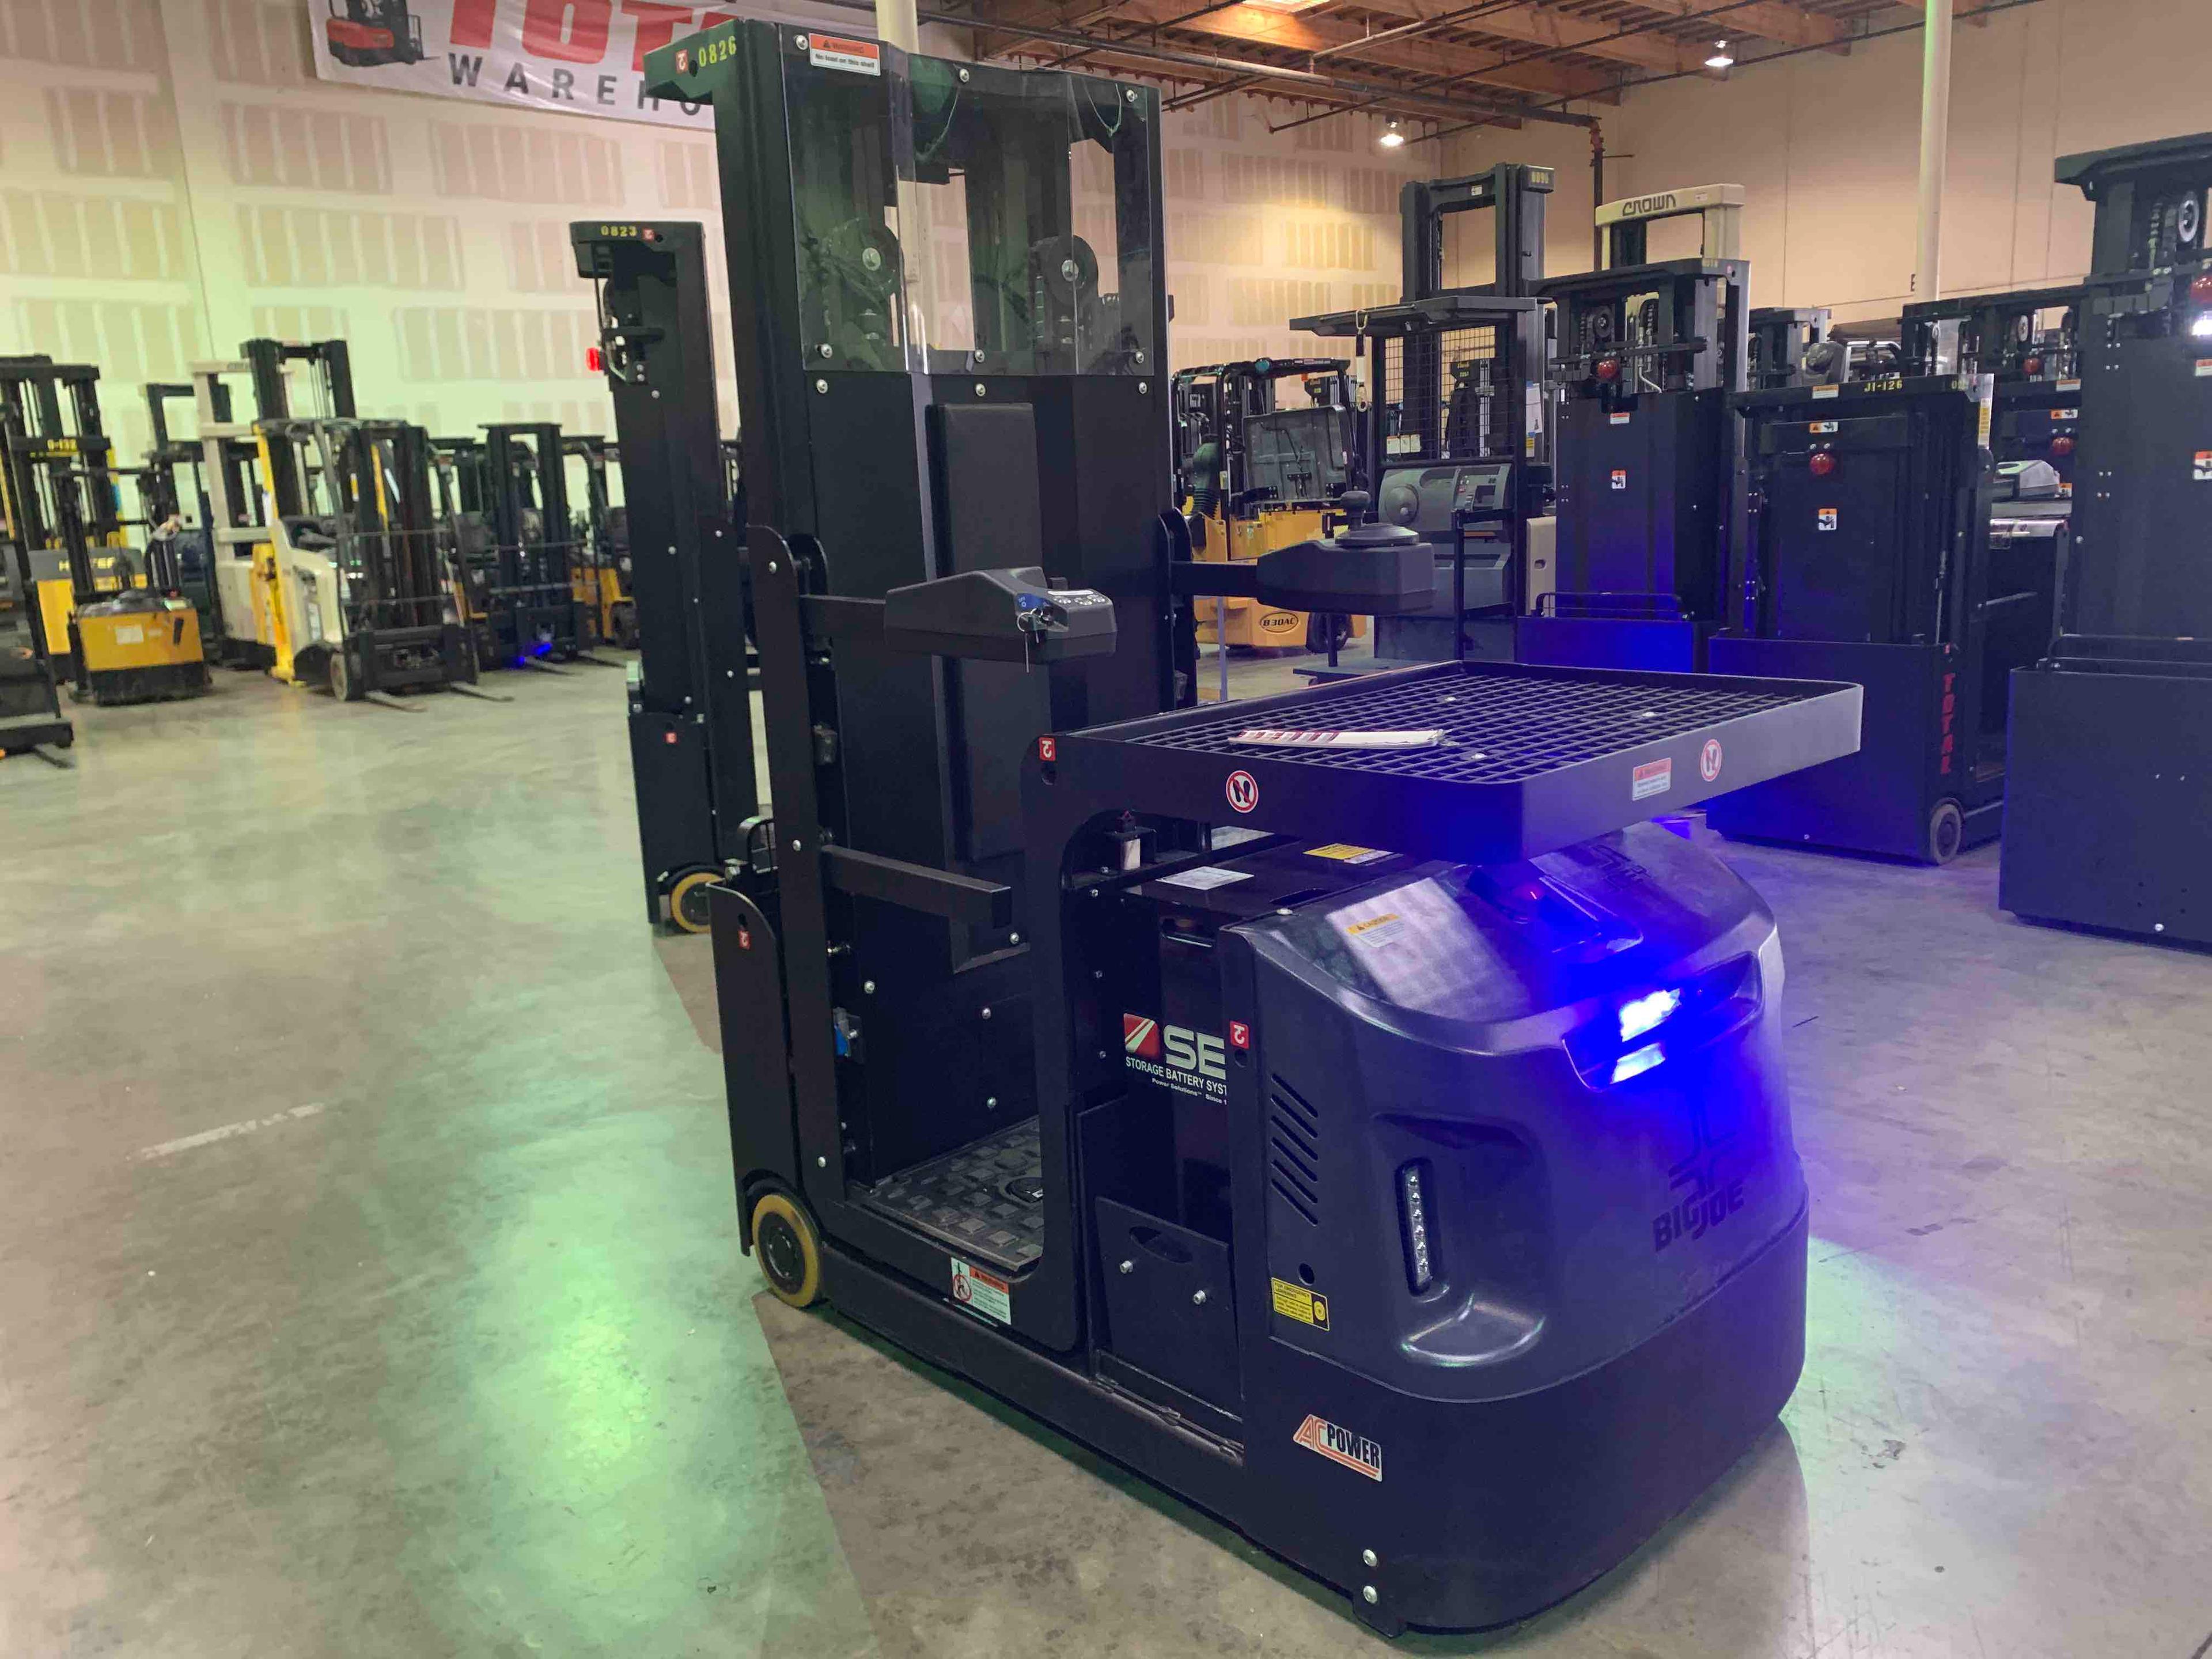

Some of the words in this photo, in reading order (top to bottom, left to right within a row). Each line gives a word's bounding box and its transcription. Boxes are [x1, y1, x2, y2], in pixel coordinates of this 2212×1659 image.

[698, 35, 737, 67] 0826
[1623, 194, 1676, 217] CROWN
[1125, 1056, 1164, 1077] STORAGE
[1165, 1068, 1205, 1089] BATTERY
[1152, 1077, 1169, 1087] Power
[1205, 1093, 1222, 1104] Since
[1327, 1423, 1380, 1469] POWER
